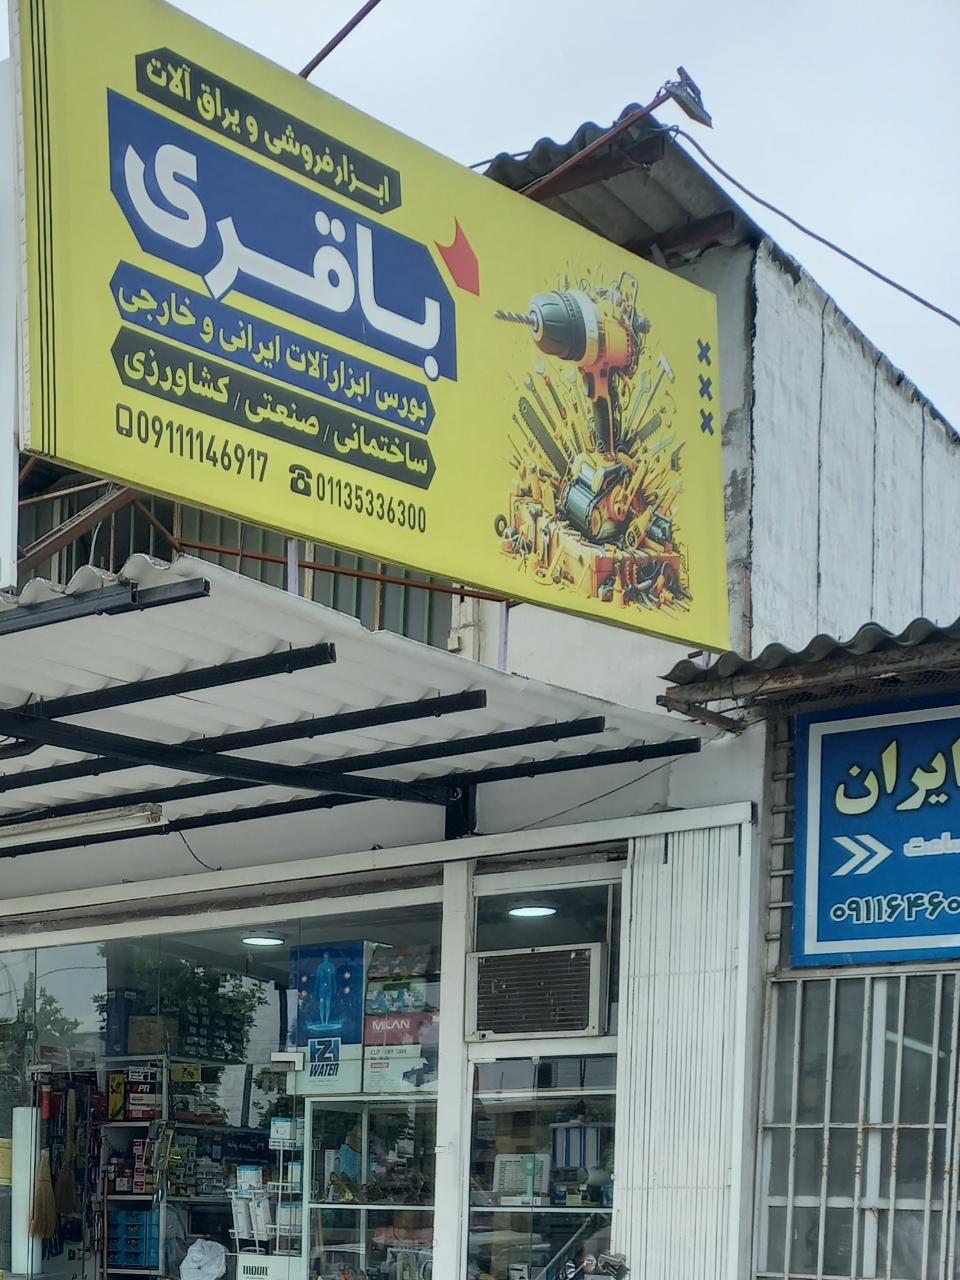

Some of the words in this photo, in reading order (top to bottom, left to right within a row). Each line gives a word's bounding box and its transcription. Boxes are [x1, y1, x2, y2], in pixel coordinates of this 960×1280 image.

[146, 58, 191, 101] آلات
[197, 83, 241, 134] یراق
[245, 115, 259, 143] و
[124, 144, 440, 381] باقری
[118, 285, 196, 326] خارجی
[200, 316, 214, 343] و
[219, 320, 281, 369] ایرانی
[123, 347, 230, 403] کشاورزی
[244, 392, 320, 436] صنعتی
[375, 388, 428, 427] بورس
[137, 410, 268, 482] 09111146917
[333, 422, 429, 475] ساختمانی
[316, 472, 426, 534] 01135336300
[309, 1063, 340, 1078] WATER
